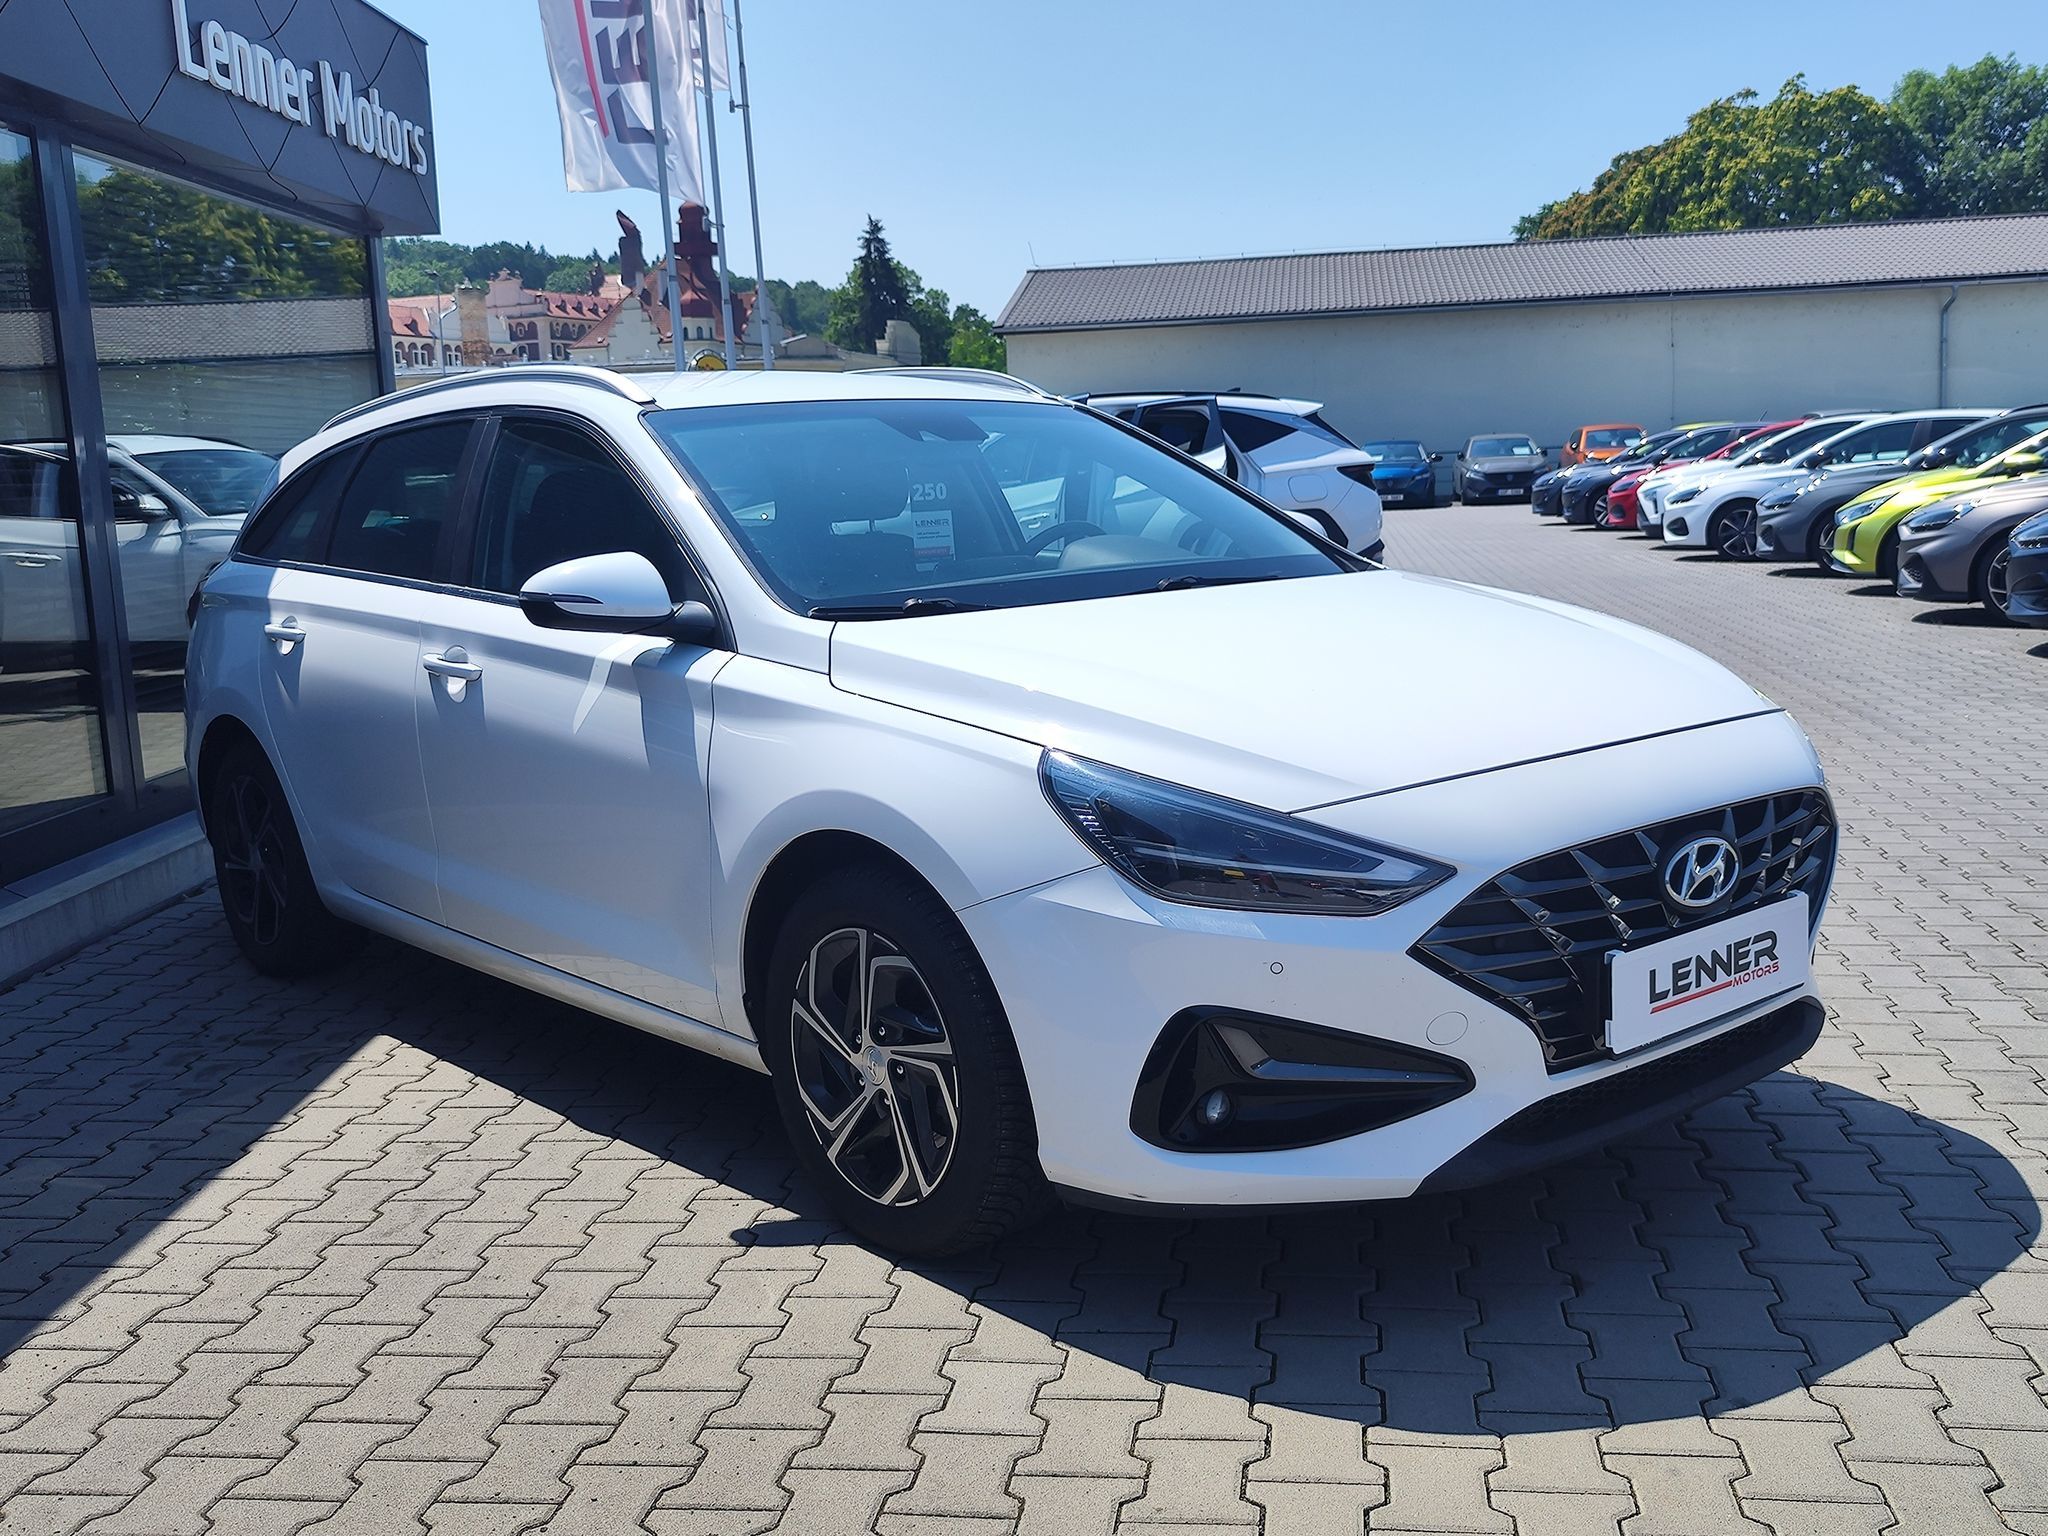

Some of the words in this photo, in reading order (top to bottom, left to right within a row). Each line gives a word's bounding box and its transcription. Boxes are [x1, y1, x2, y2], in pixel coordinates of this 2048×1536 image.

[171, 0, 313, 127] Lenner
[318, 60, 428, 176] Motors
[912, 482, 947, 501] 250
[1649, 930, 1779, 1004] LENNER
[1732, 961, 1780, 987] MOTORS
